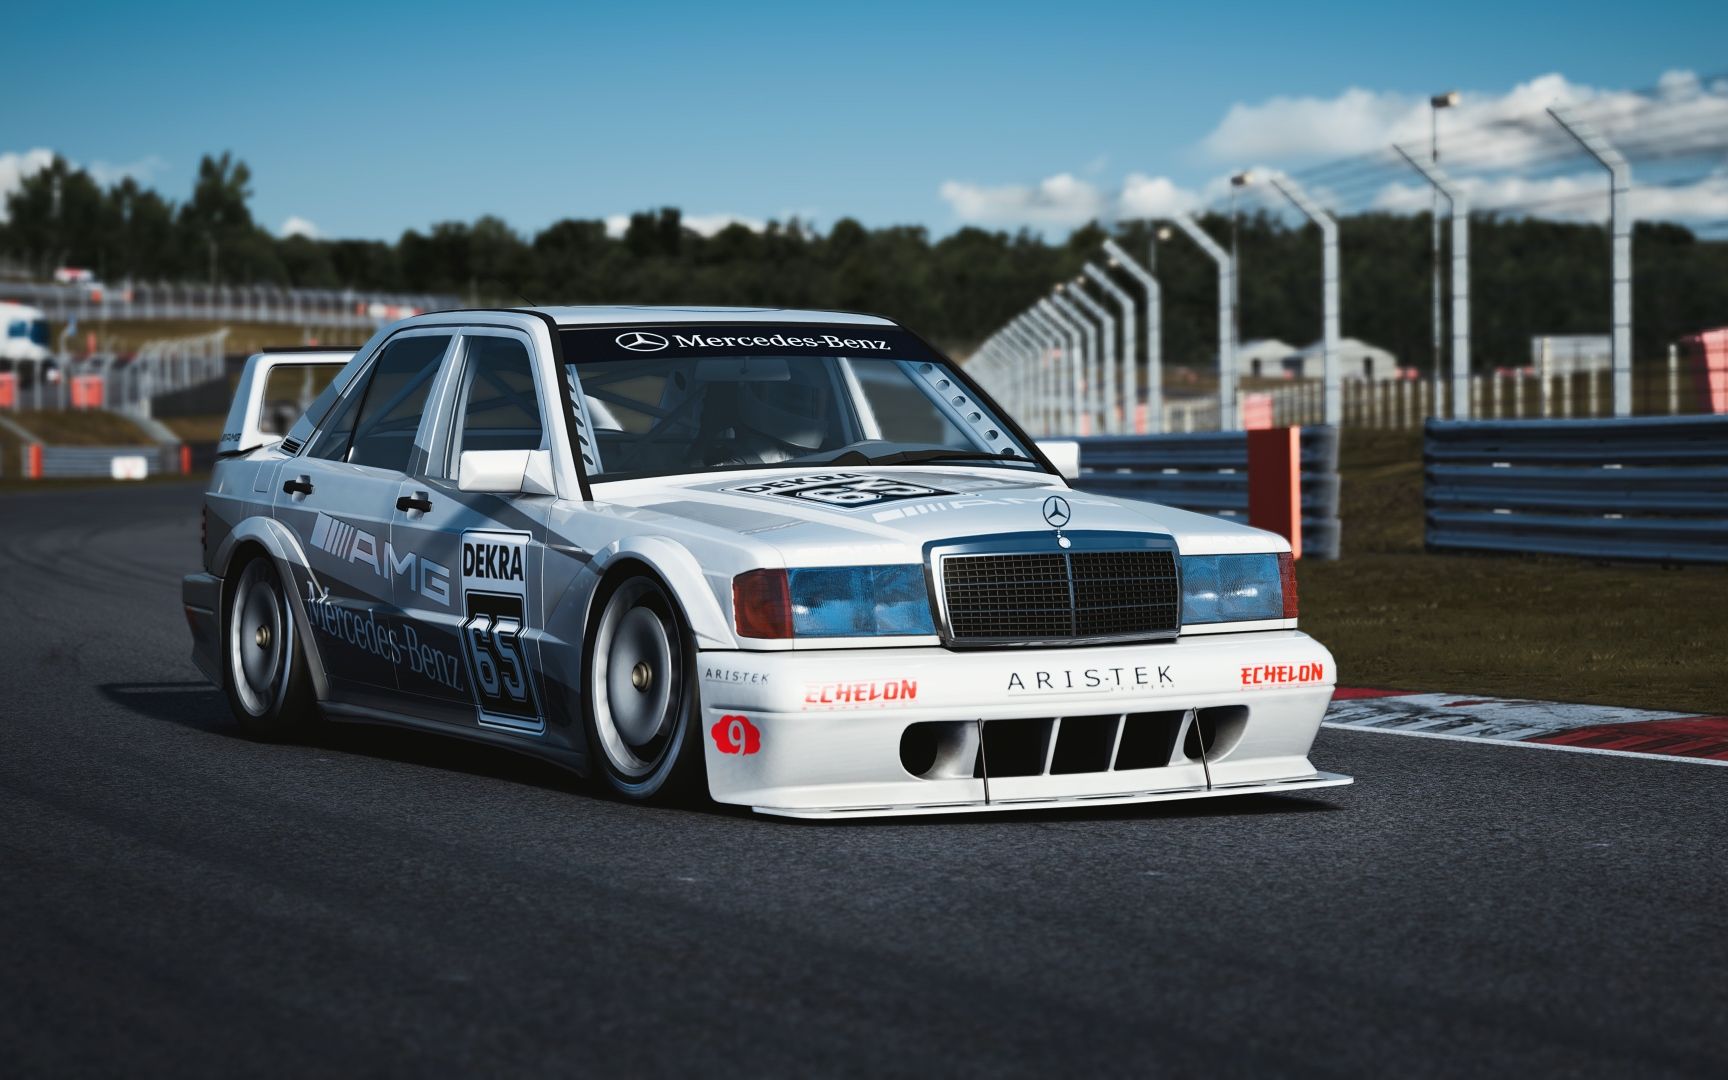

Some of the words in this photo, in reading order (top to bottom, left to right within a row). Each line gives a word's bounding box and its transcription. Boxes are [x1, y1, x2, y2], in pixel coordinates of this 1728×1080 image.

[672, 334, 891, 350] Mercedes-Benz
[738, 472, 870, 494] DEKRA
[349, 529, 450, 607] AMG
[463, 543, 525, 582] DEKRA
[306, 580, 464, 692] Mercedes-Benz
[466, 613, 528, 702] 65
[1241, 662, 1324, 685] ECHELON
[804, 679, 917, 703] ECHELON
[728, 719, 747, 756] 9
